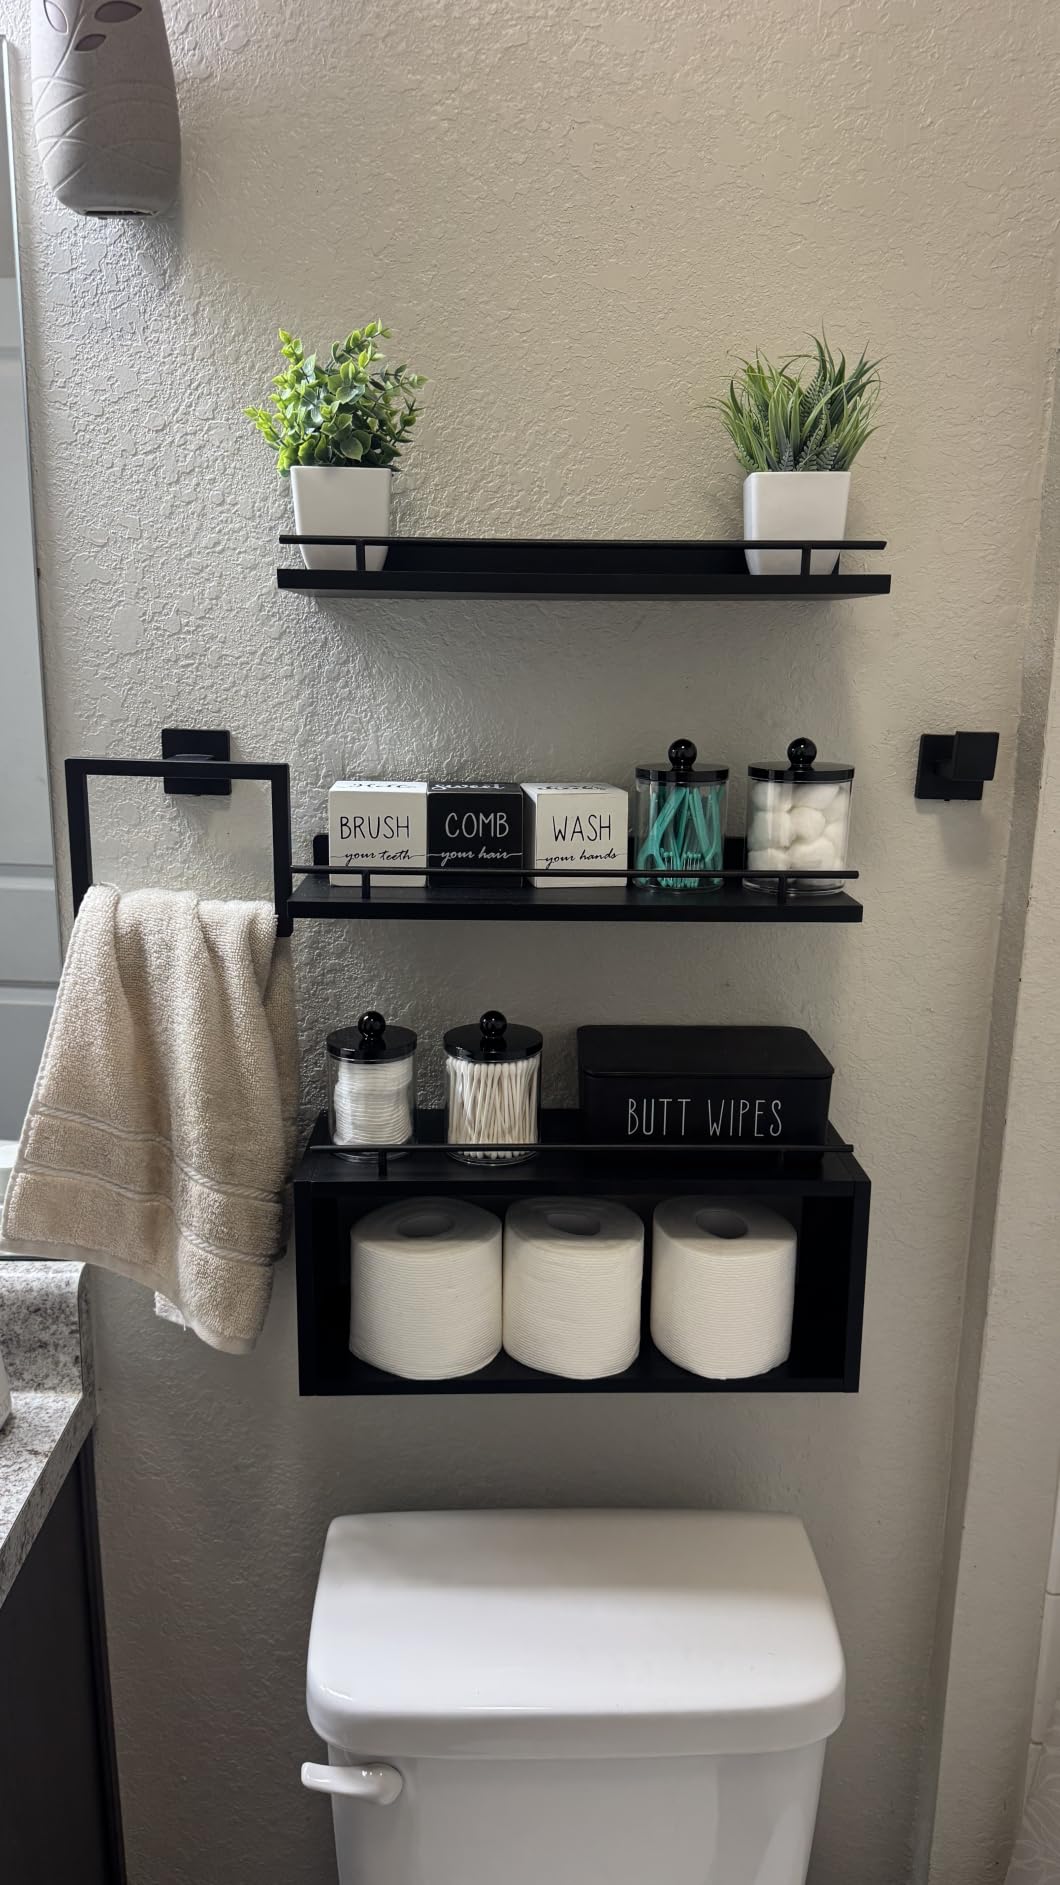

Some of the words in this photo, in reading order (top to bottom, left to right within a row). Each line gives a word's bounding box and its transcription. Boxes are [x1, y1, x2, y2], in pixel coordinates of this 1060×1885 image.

[340, 816, 410, 840] BRUSH
[445, 812, 509, 838] COMB
[552, 814, 611, 842] WASH
[344, 851, 376, 867] your
[379, 849, 414, 861] teeth
[440, 851, 475, 867] your
[478, 845, 512, 859] hair
[545, 856, 576, 869] your
[579, 847, 617, 861] hands
[628, 1098, 691, 1136] BUTT
[707, 1099, 782, 1137] WIPES
